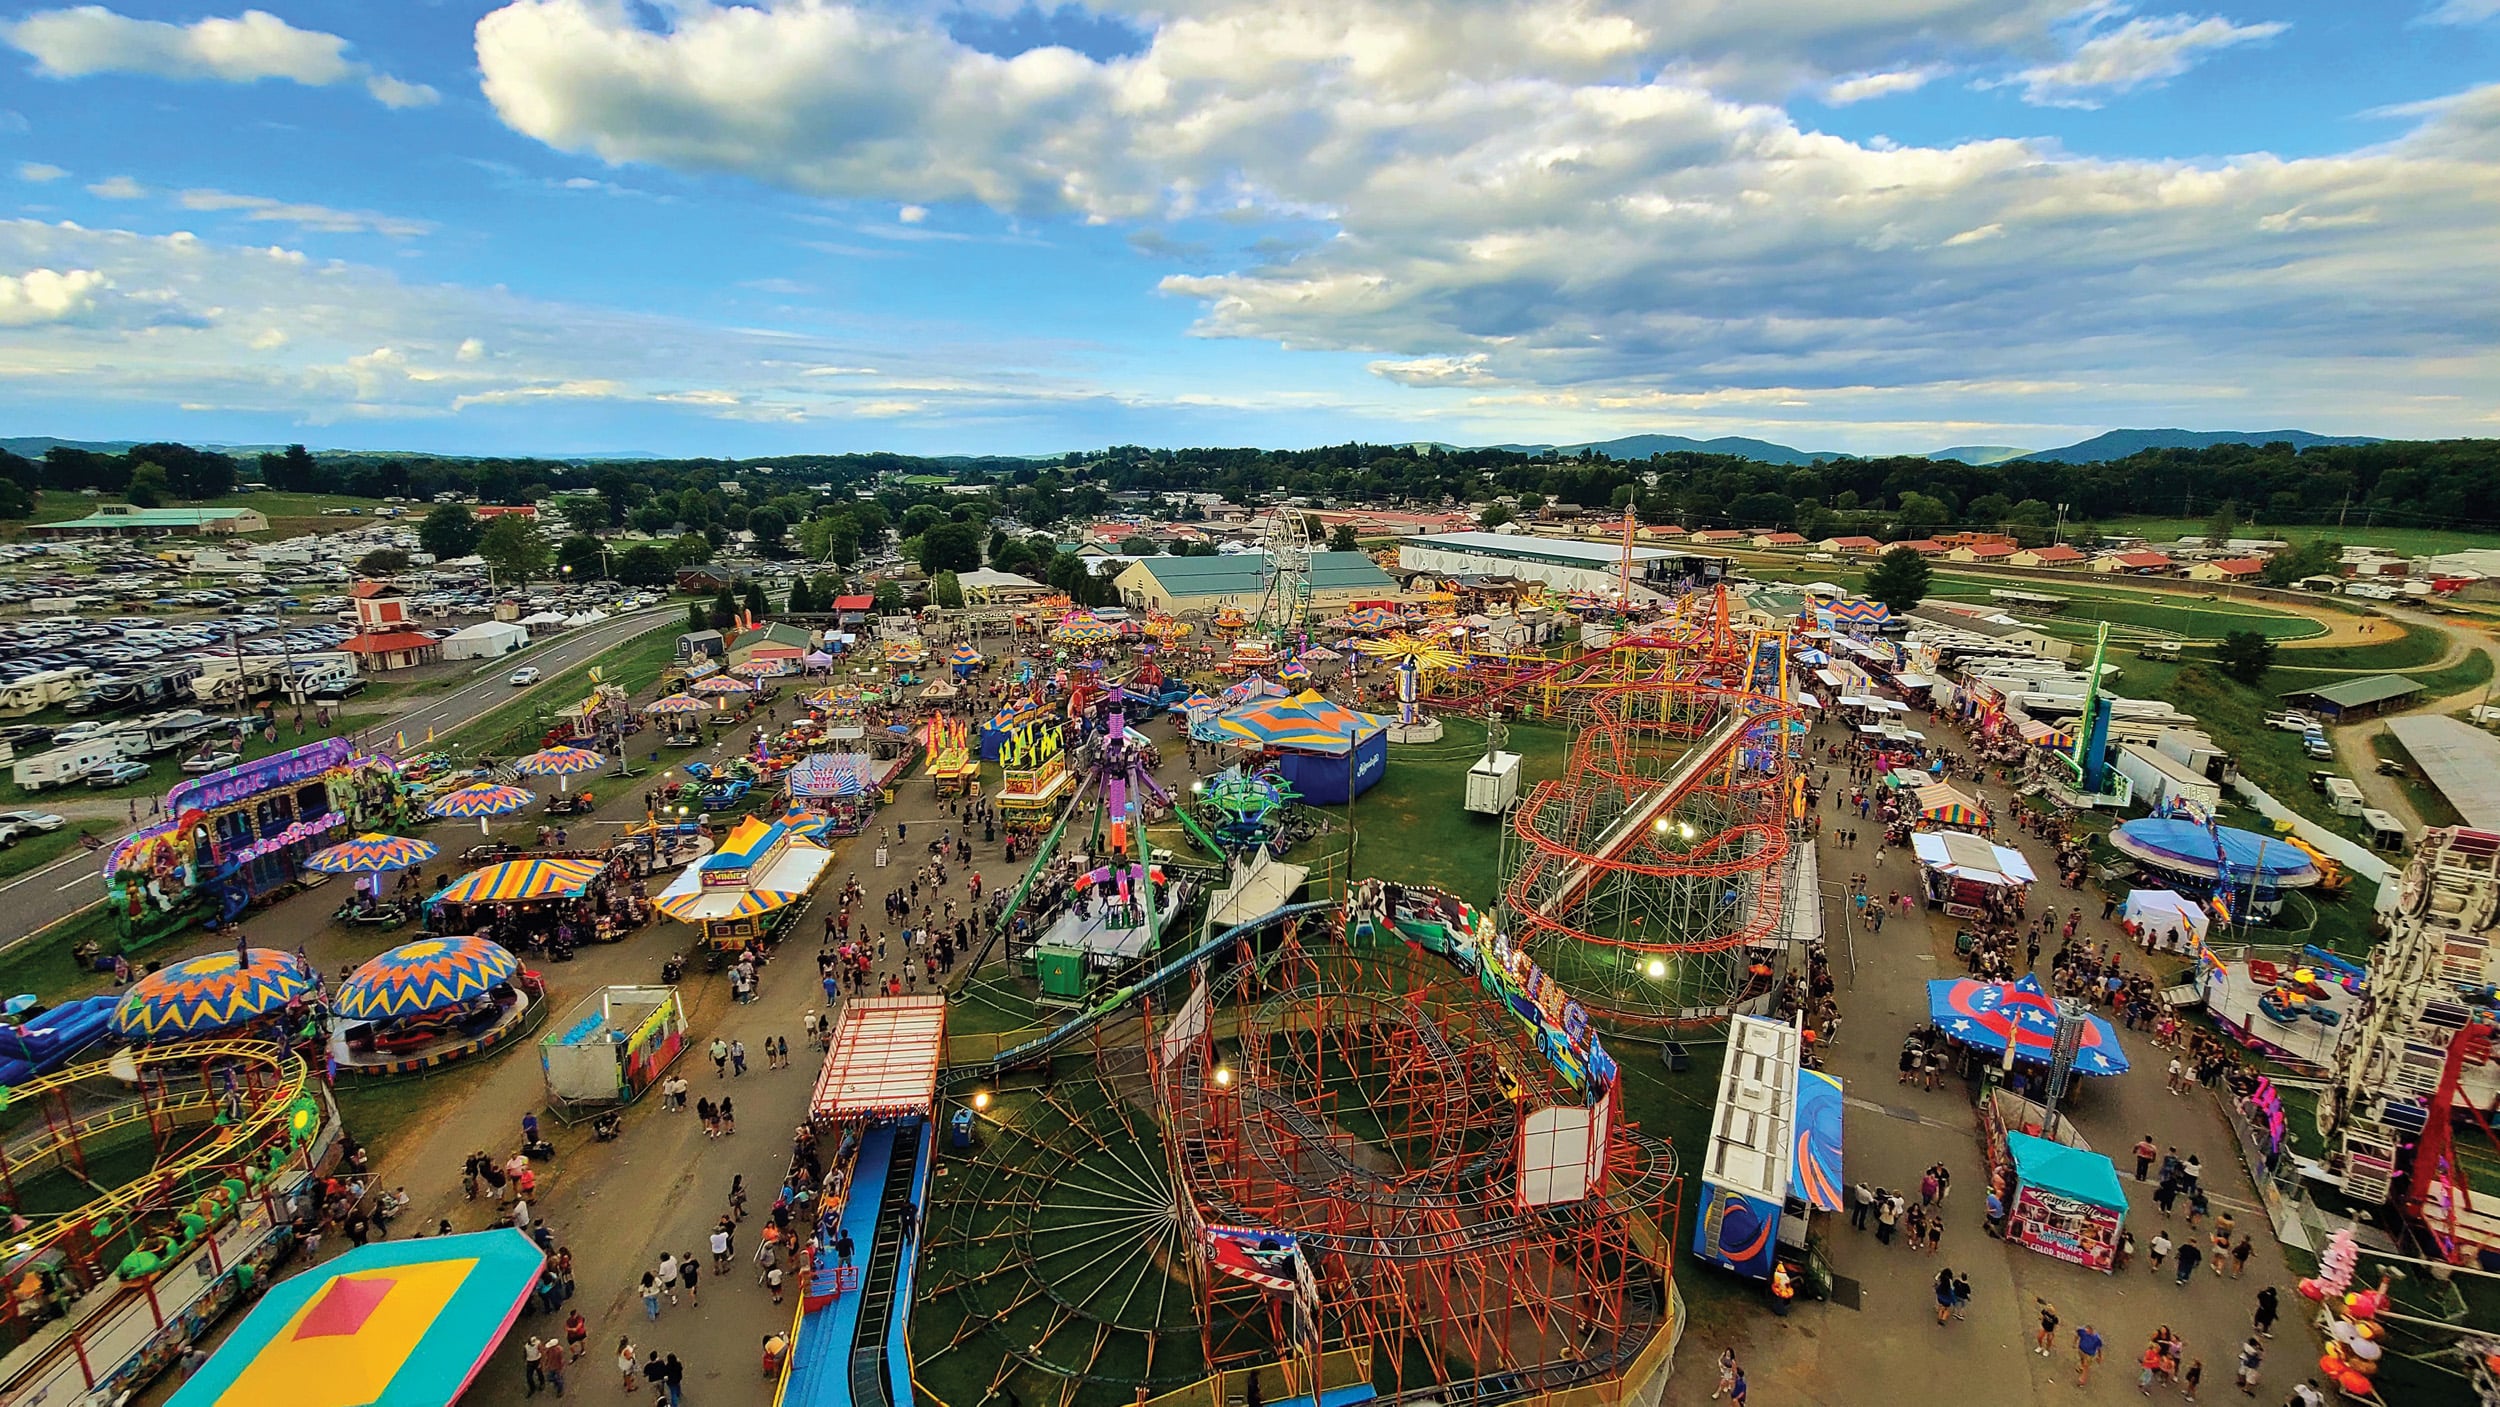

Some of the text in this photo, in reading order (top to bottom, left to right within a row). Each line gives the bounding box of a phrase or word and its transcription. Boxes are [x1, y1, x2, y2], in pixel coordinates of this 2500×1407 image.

[204, 754, 327, 805] MAGIC MAZE
[1477, 911, 1589, 1042] RACING
[2030, 1243, 2083, 1264] COLOR BRAIDS
[2056, 1241, 2084, 1255] WRAPS
